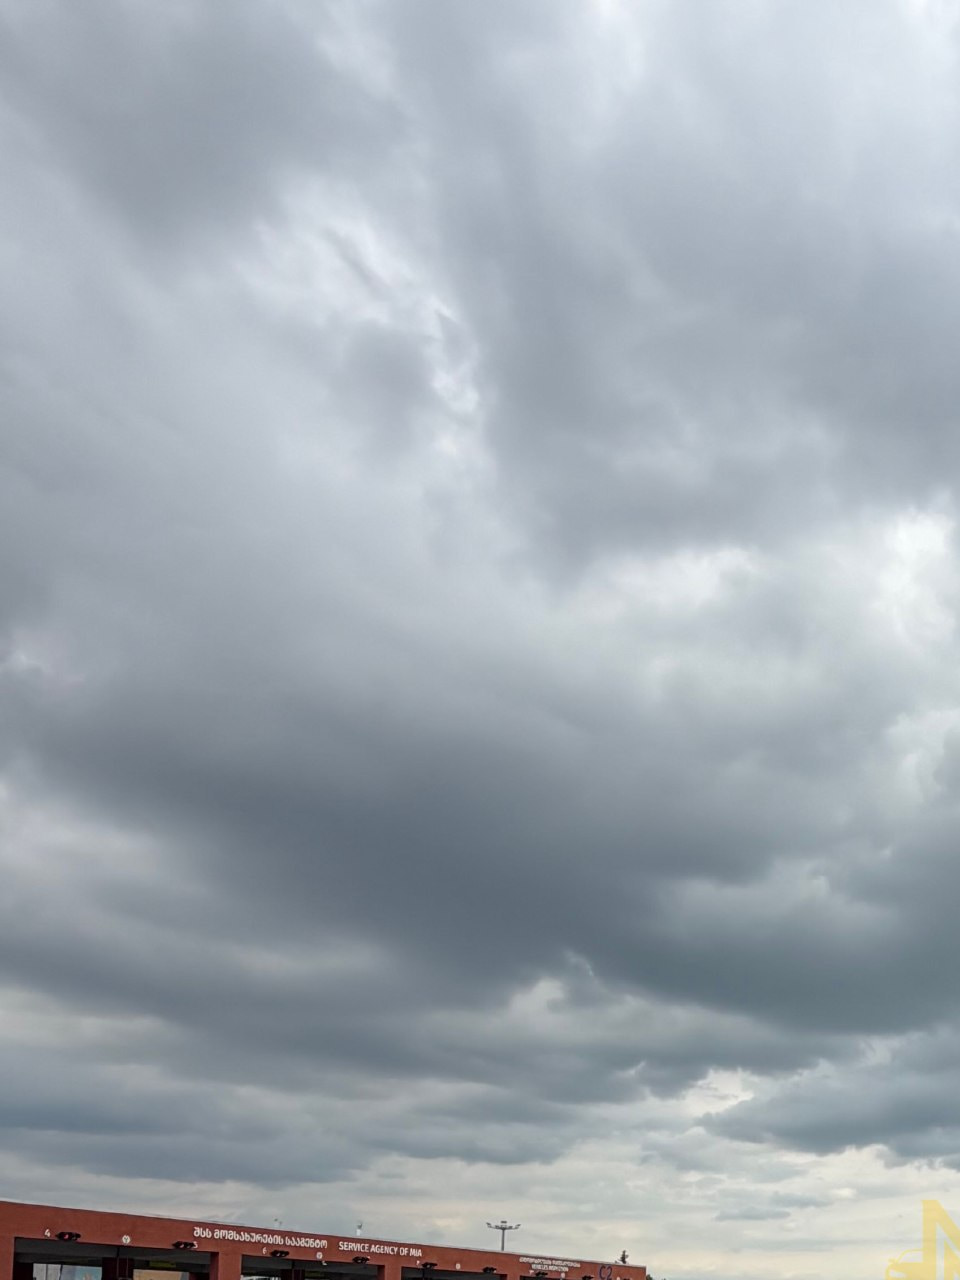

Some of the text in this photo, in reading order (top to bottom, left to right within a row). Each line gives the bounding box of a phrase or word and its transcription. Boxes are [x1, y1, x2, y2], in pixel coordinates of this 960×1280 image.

[338, 1241, 422, 1257] SERVICE AGENCY OF MIA
[599, 1265, 613, 1280] C2
